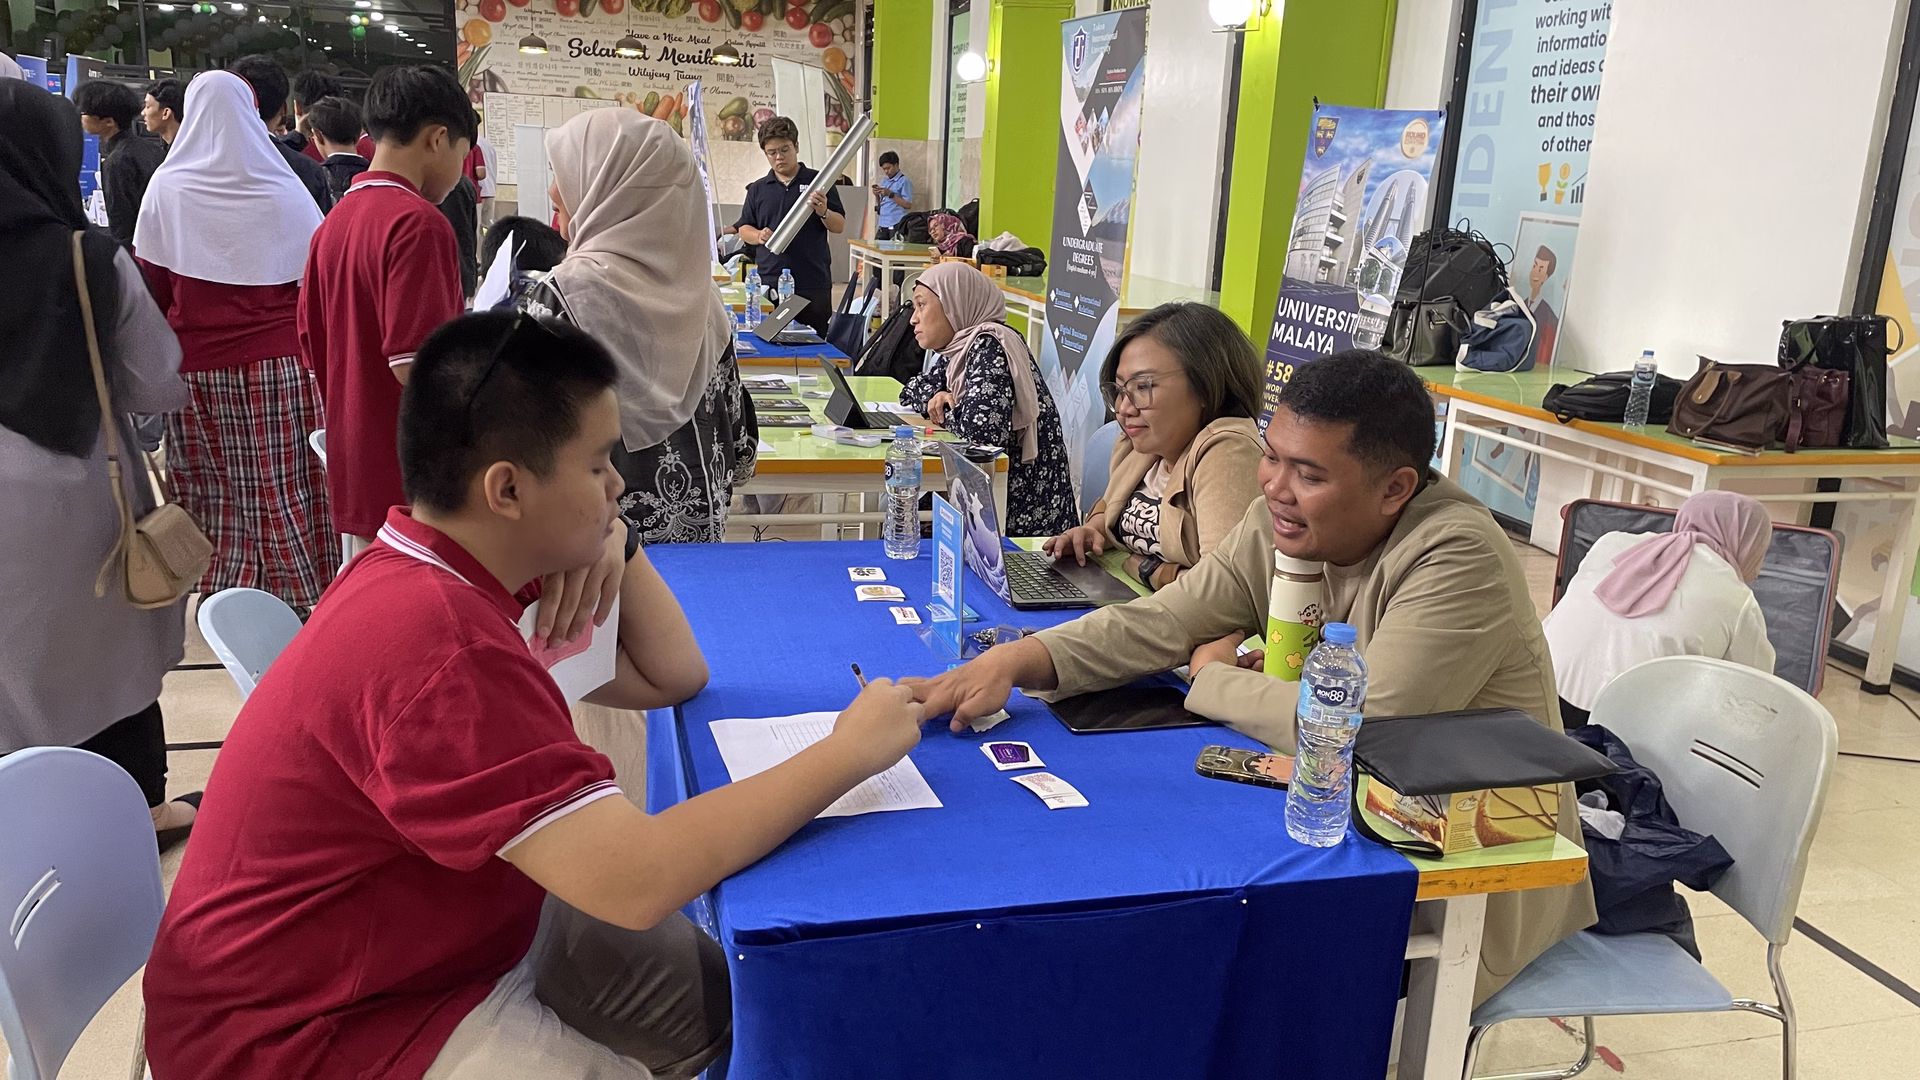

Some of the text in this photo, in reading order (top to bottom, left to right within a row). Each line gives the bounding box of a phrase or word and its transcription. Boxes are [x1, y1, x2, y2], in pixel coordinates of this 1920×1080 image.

[1535, 2, 1612, 29] working wit
[662, 32, 683, 43] Nice
[686, 34, 711, 45] Meal
[1537, 29, 1607, 53] informatio
[1532, 58, 1596, 78] and ideas
[1531, 81, 1568, 104] their
[1538, 112, 1564, 128] and
[1541, 136, 1593, 152] of other
[1271, 321, 1334, 356] MALAYA
[1265, 360, 1295, 384] #58
